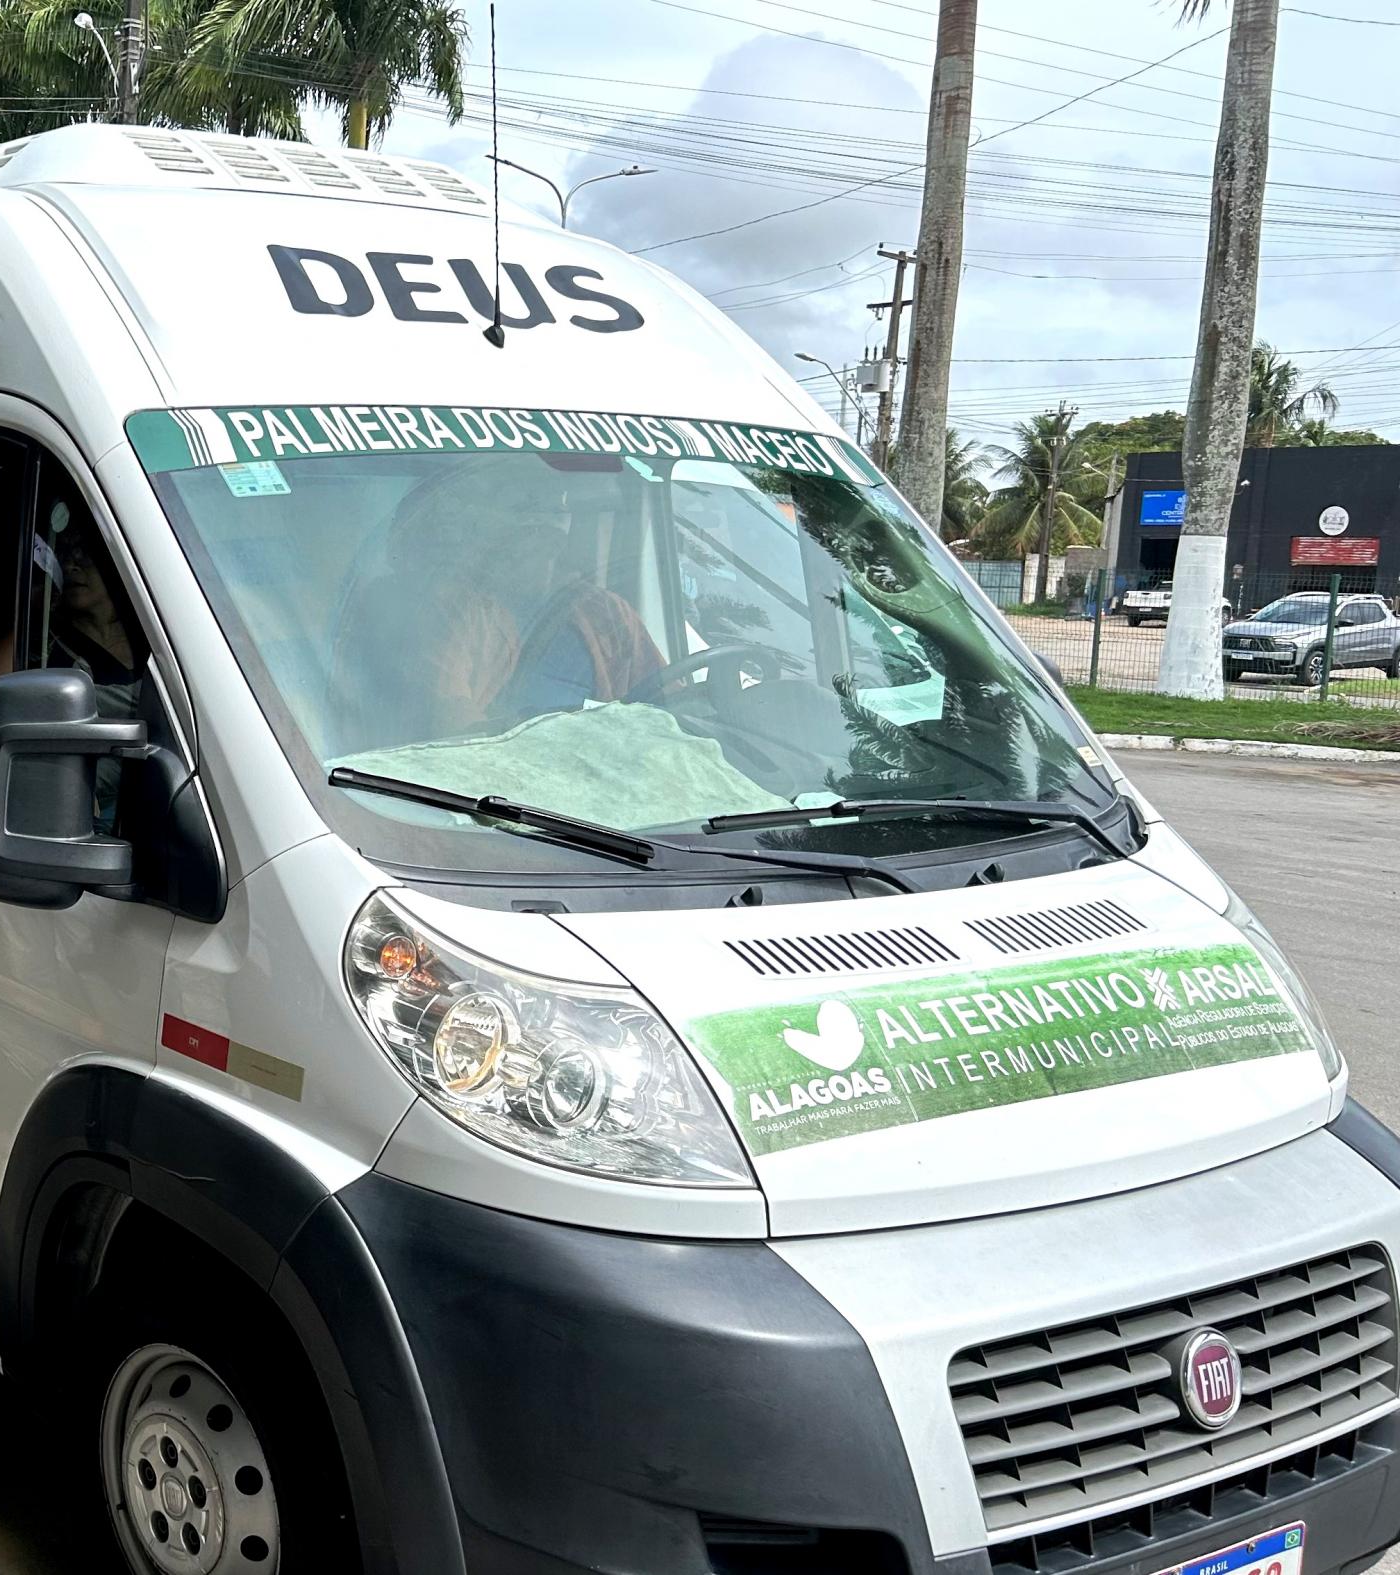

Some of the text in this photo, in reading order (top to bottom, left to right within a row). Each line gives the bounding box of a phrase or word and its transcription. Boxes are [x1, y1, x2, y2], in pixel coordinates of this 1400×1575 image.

[266, 244, 645, 333] DEUS
[227, 406, 834, 476] PALMEIRA DOS INDIOS MACEIÓ
[876, 972, 1146, 1049] ALTERNATIVO
[1177, 962, 1277, 1006] ARSAL
[895, 1022, 1181, 1094] INTERMUNICIPAL
[749, 1067, 892, 1121] ALAGOAS
[754, 1096, 901, 1136] TRABALHAR MAIS PARA FAZER MAIS
[1197, 1357, 1232, 1404] FIAT
[1199, 1560, 1229, 1575] BRASIL
